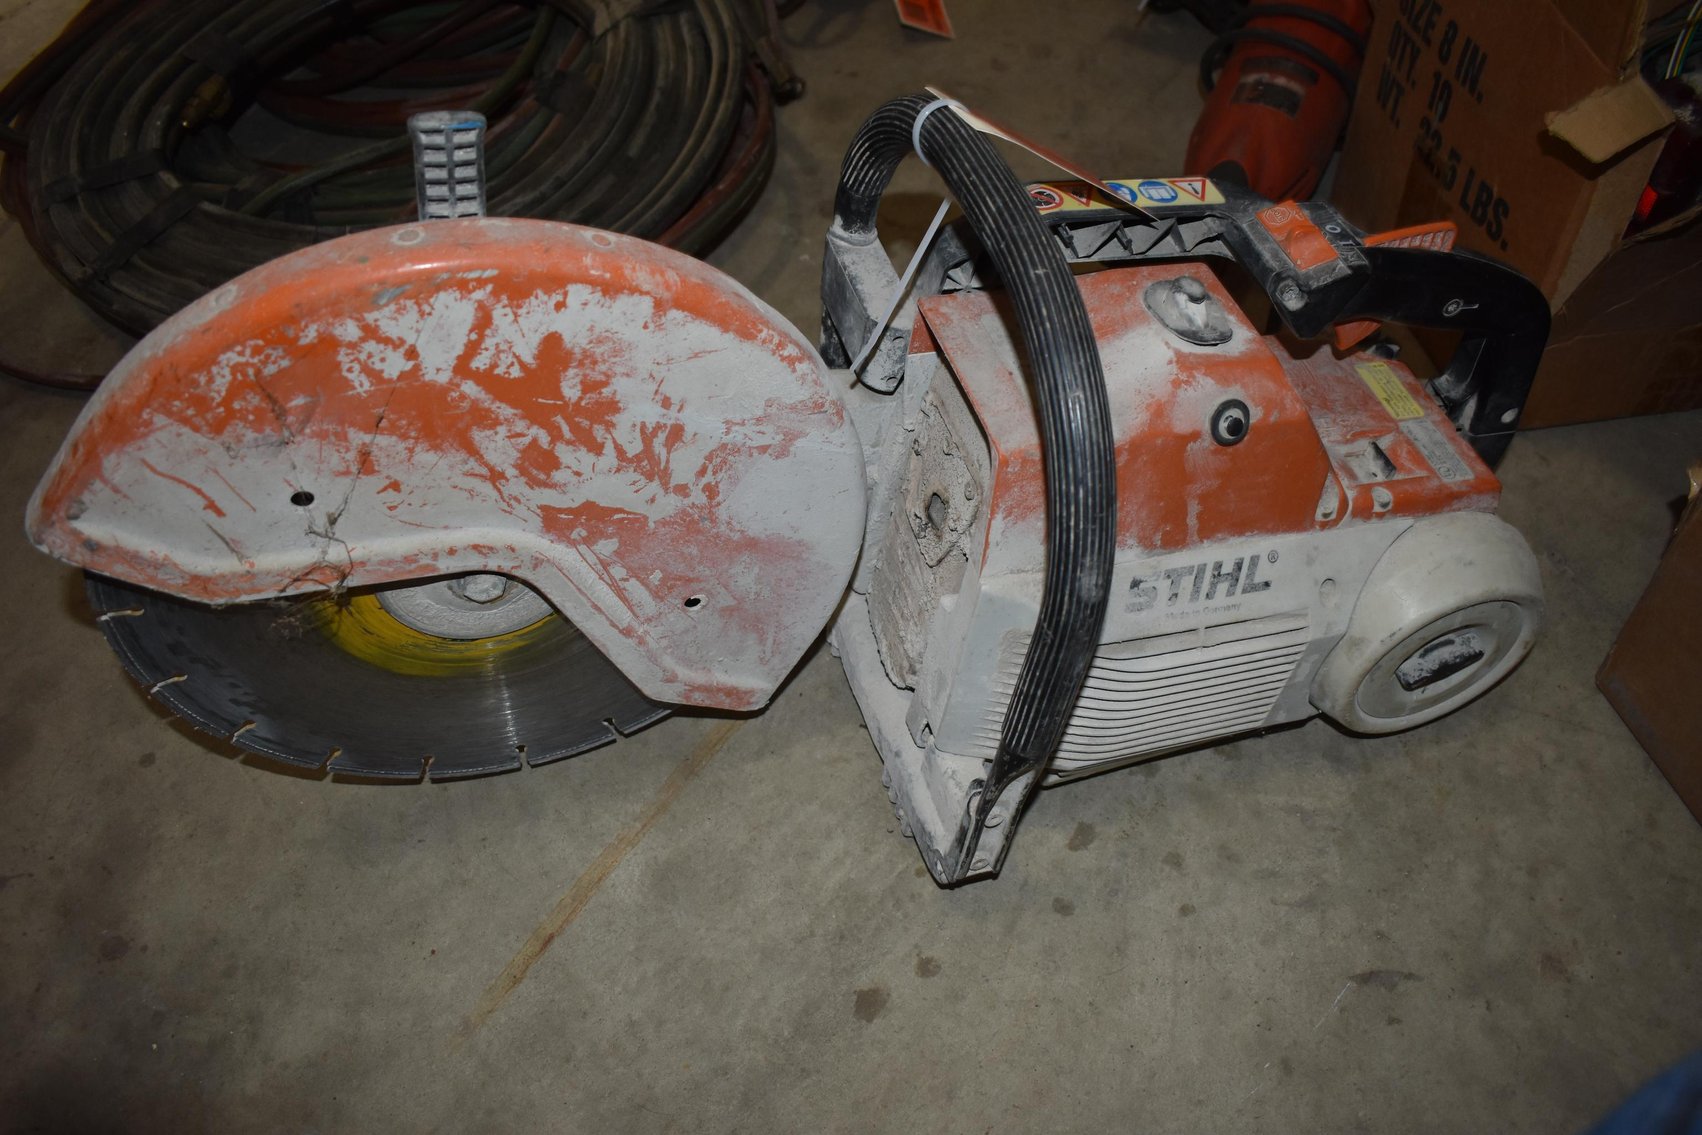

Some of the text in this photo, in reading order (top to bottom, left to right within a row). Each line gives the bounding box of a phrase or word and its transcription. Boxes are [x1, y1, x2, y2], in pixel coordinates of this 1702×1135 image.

[1388, 20, 1420, 90] QTY.
[1438, 19, 1459, 66] 8
[1454, 36, 1488, 104] IN.
[1377, 61, 1405, 129] WT.
[1459, 167, 1510, 252] LBS.
[1203, 602, 1242, 616] Germany
